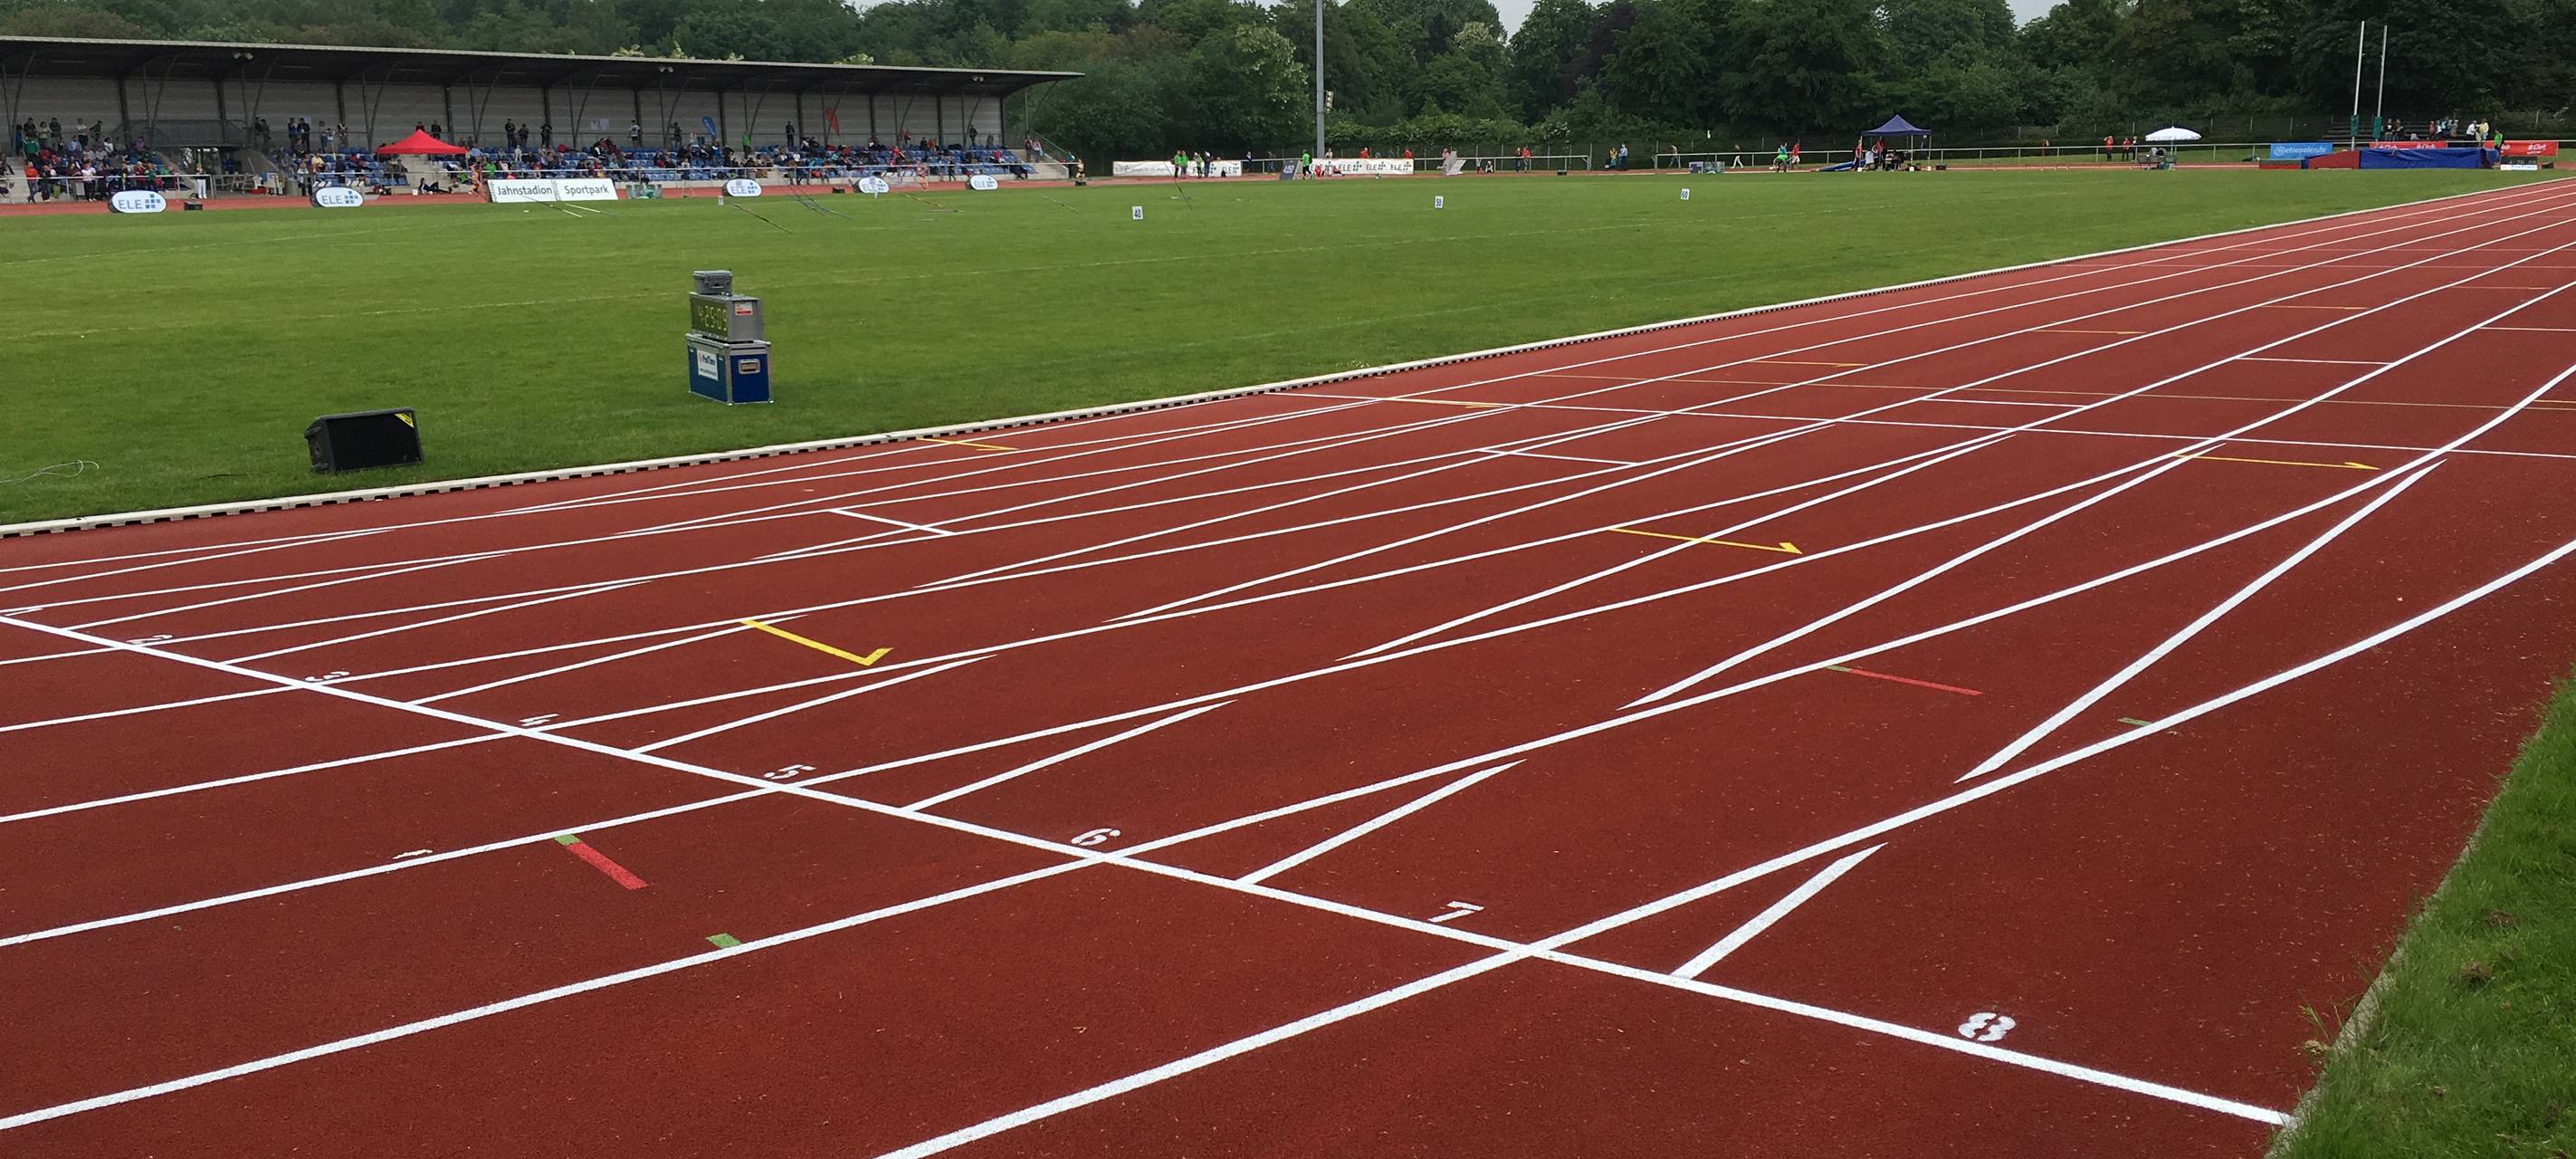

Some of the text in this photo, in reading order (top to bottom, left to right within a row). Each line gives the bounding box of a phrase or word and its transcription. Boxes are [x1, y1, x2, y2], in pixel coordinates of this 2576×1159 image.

[498, 185, 552, 196] Jahnstadion
[564, 185, 609, 196] Sportpark
[118, 199, 143, 210] ELE
[321, 196, 343, 205] ELE
[304, 671, 350, 682] 3
[763, 764, 817, 780] 5
[1071, 828, 1121, 846] 6
[1427, 900, 1484, 923] 7
[1957, 1011, 2017, 1041] 8
